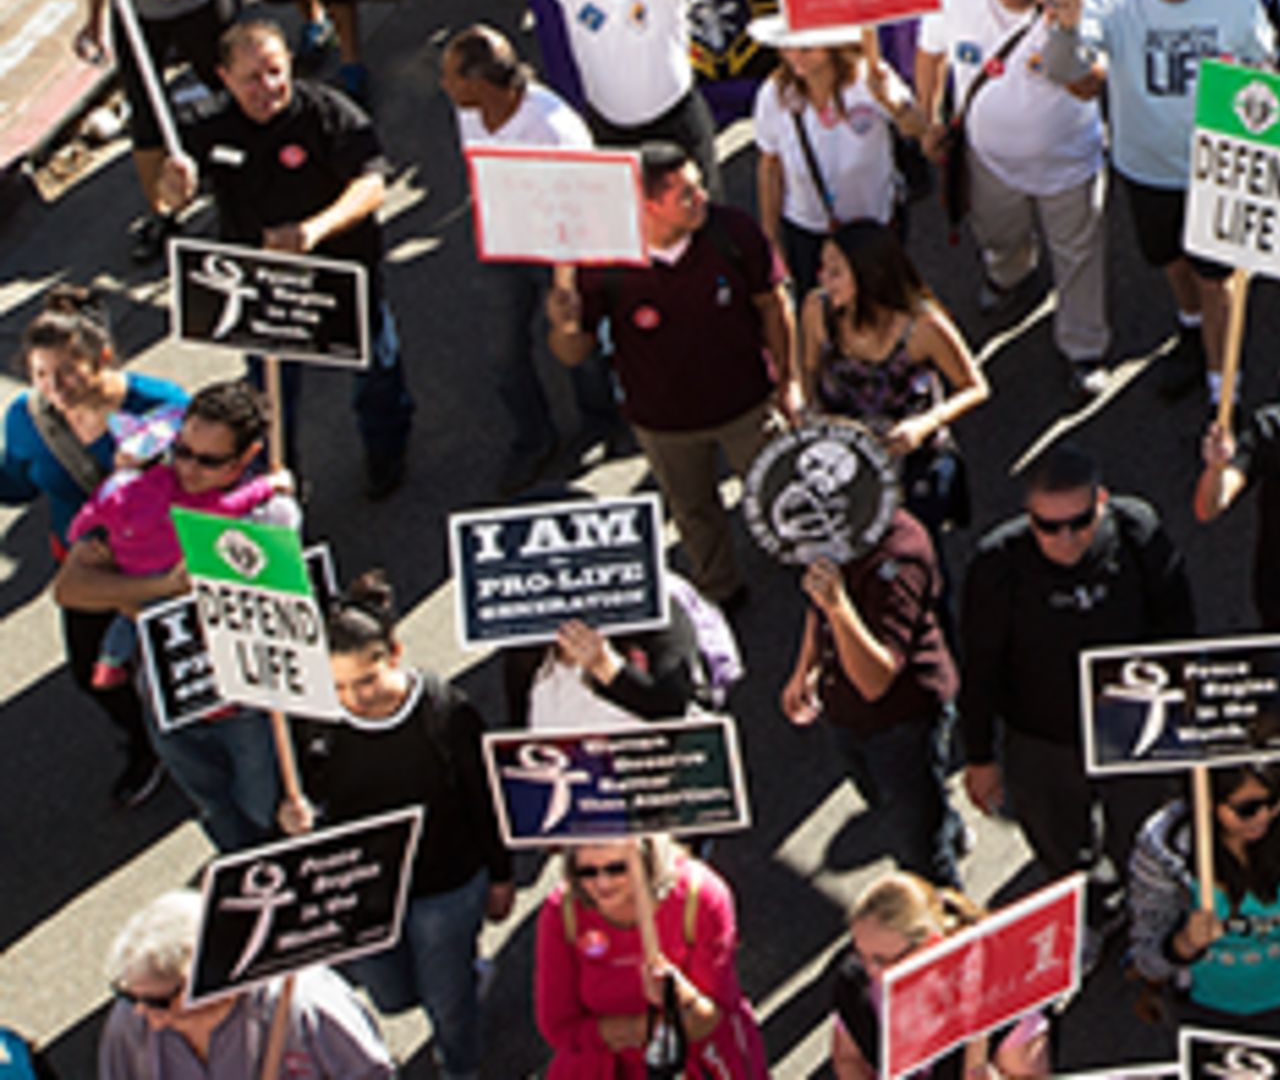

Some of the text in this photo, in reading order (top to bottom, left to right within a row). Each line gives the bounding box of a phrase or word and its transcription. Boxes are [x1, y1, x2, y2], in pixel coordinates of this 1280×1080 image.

[1212, 194, 1275, 254] LIFE
[475, 508, 642, 562] I AM
[477, 562, 646, 599] PRO-LIFE
[196, 583, 319, 646] DEFEND
[234, 639, 304, 696] LIFE
